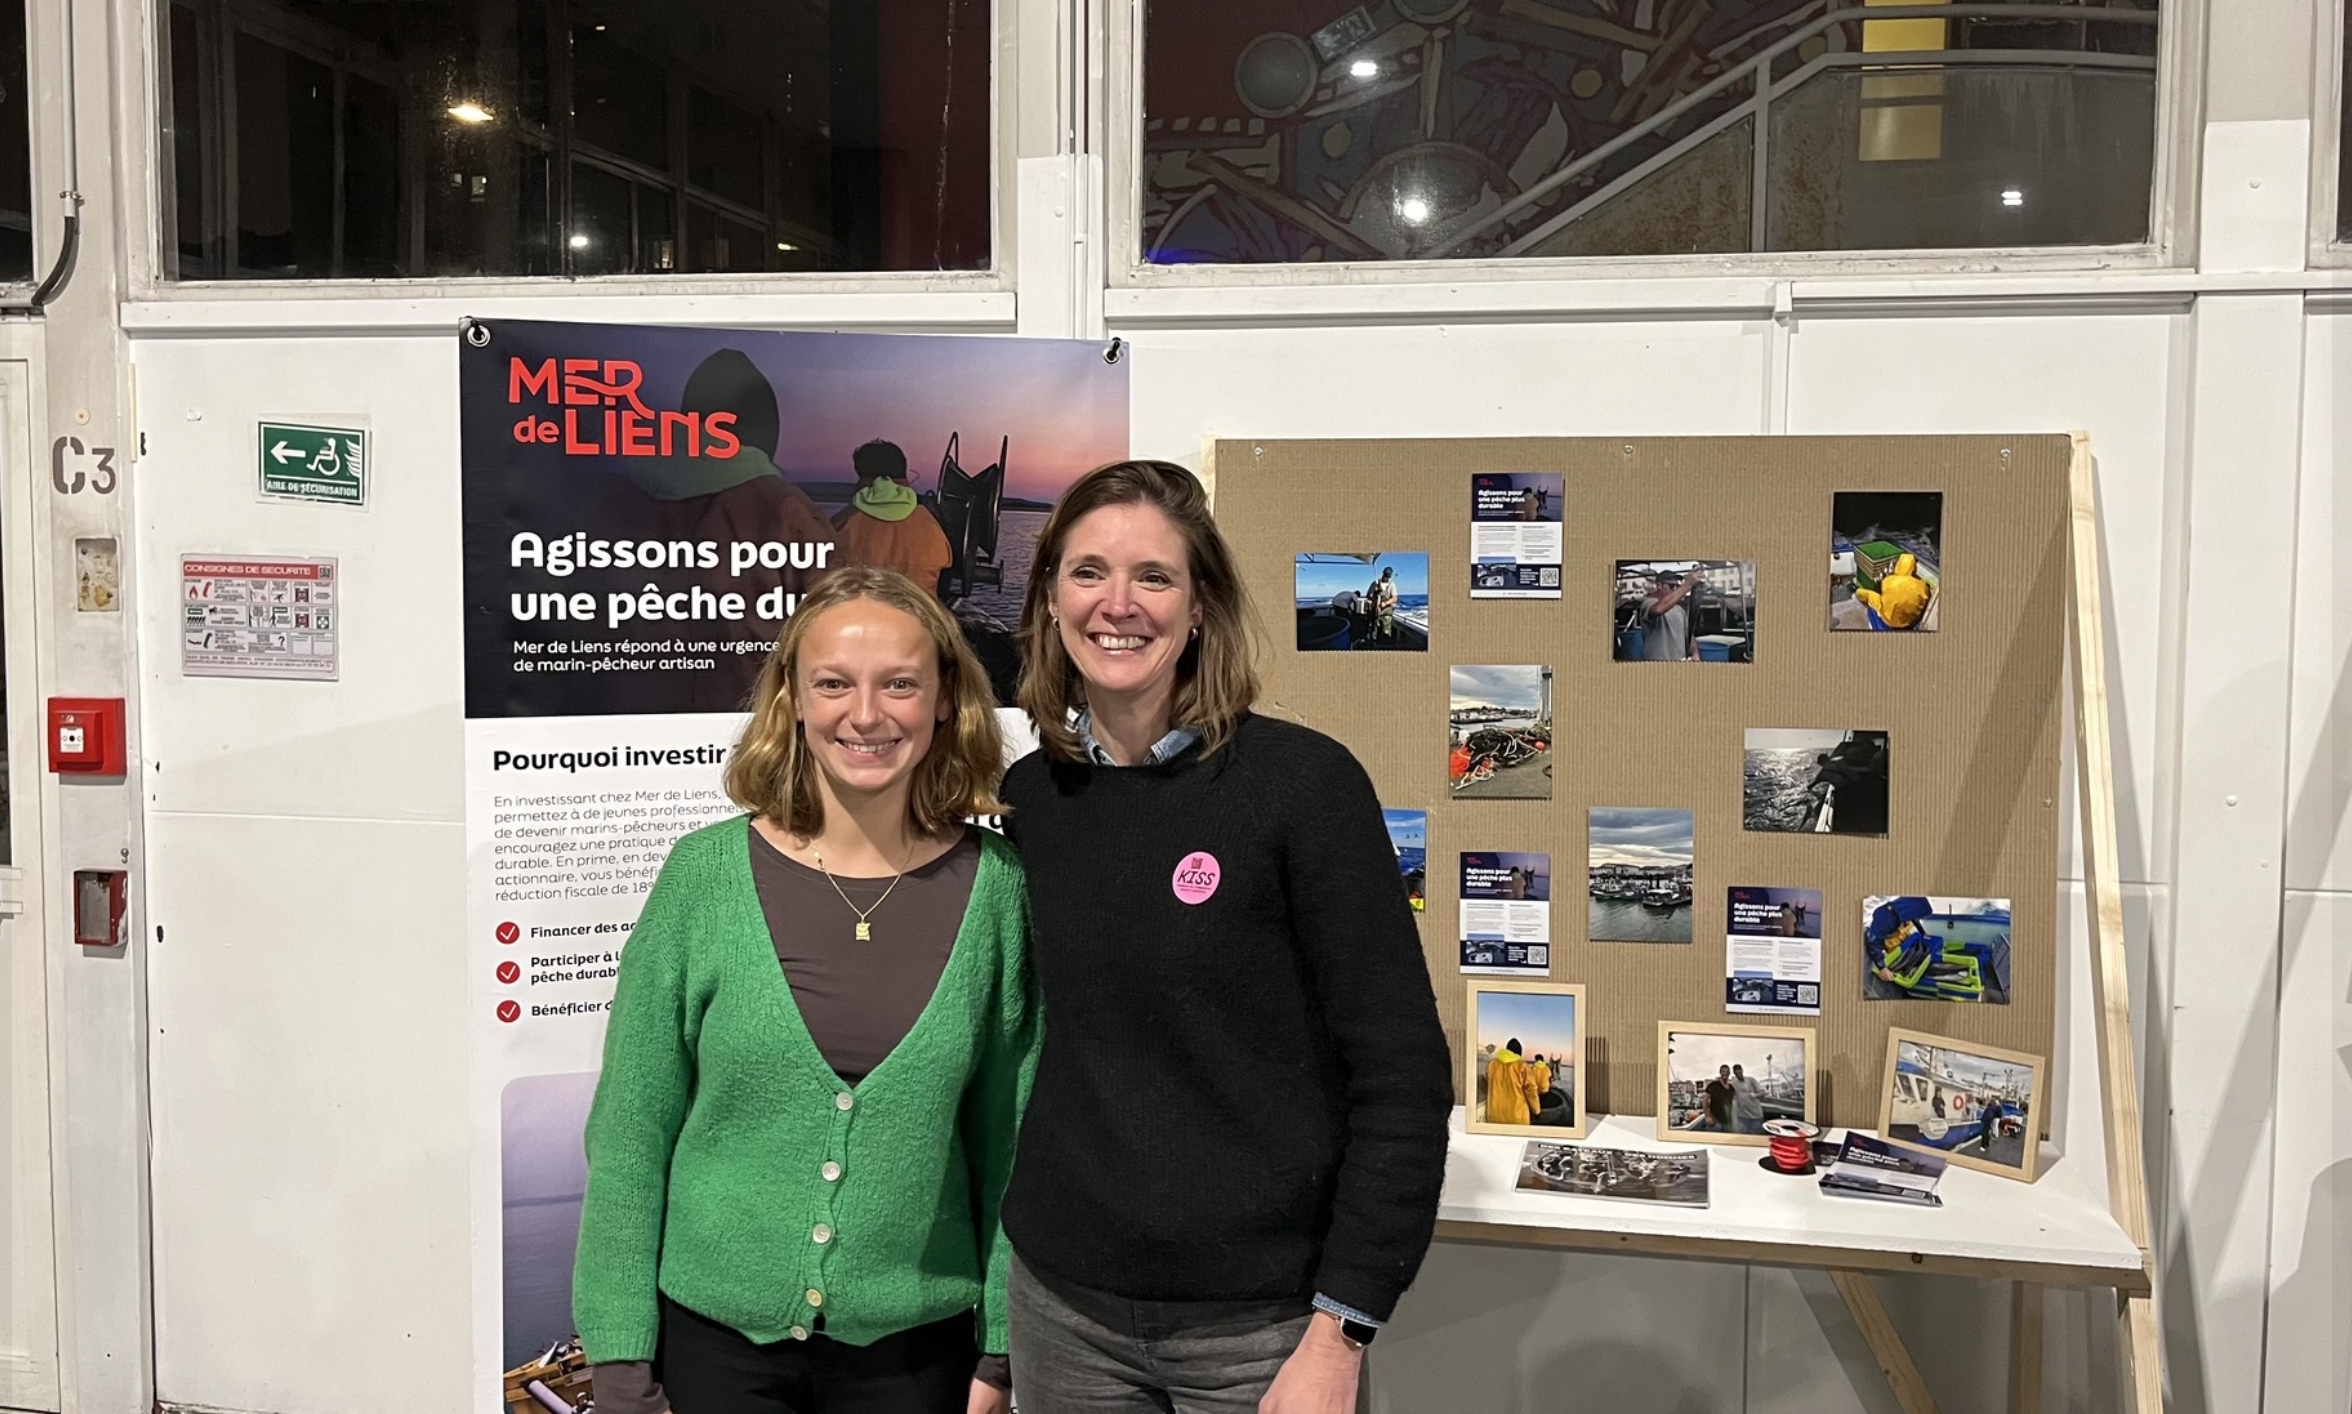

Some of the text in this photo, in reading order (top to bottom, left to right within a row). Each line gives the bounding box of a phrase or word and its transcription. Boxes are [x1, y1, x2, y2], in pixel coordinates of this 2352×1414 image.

[508, 356, 655, 420] MER
[513, 409, 741, 459] de LIENS
[53, 436, 116, 495] C3
[266, 480, 358, 497] AIRE DE SÉCURISATION
[511, 531, 835, 577] Agissons pour
[184, 564, 244, 574] CONSIGNES
[245, 565, 260, 575] DE
[261, 566, 312, 576] SECURITE
[511, 592, 597, 621] une
[608, 583, 746, 629] pêche
[513, 638, 780, 656] Mer de Liens répond à une urgence
[513, 656, 715, 674] de marin-pêcheur artisan
[493, 744, 727, 774] Pourquoi investir
[494, 788, 722, 808] En investissant chez Mer de Liens,
[494, 811, 568, 825] permettez
[570, 808, 581, 820] à
[583, 808, 601, 819] de
[602, 806, 647, 821] jeunes
[494, 820, 704, 839] de devenir marins-pêcheurs et
[494, 842, 577, 855] encouragez
[579, 840, 606, 851] une
[608, 836, 666, 851] pratique
[494, 858, 553, 870] durable.
[556, 855, 574, 867] En
[622, 853, 640, 864] en
[581, 870, 613, 881] vous
[1177, 869, 1216, 886] KISS
[495, 888, 562, 901] réduction
[565, 885, 609, 900] fiscale
[611, 883, 628, 895] de
[530, 926, 592, 938] Financer
[594, 922, 618, 934] des
[531, 953, 601, 967] Participer
[603, 950, 613, 962] à
[531, 970, 573, 986] pêche
[531, 1001, 603, 1016] Bénéficier
